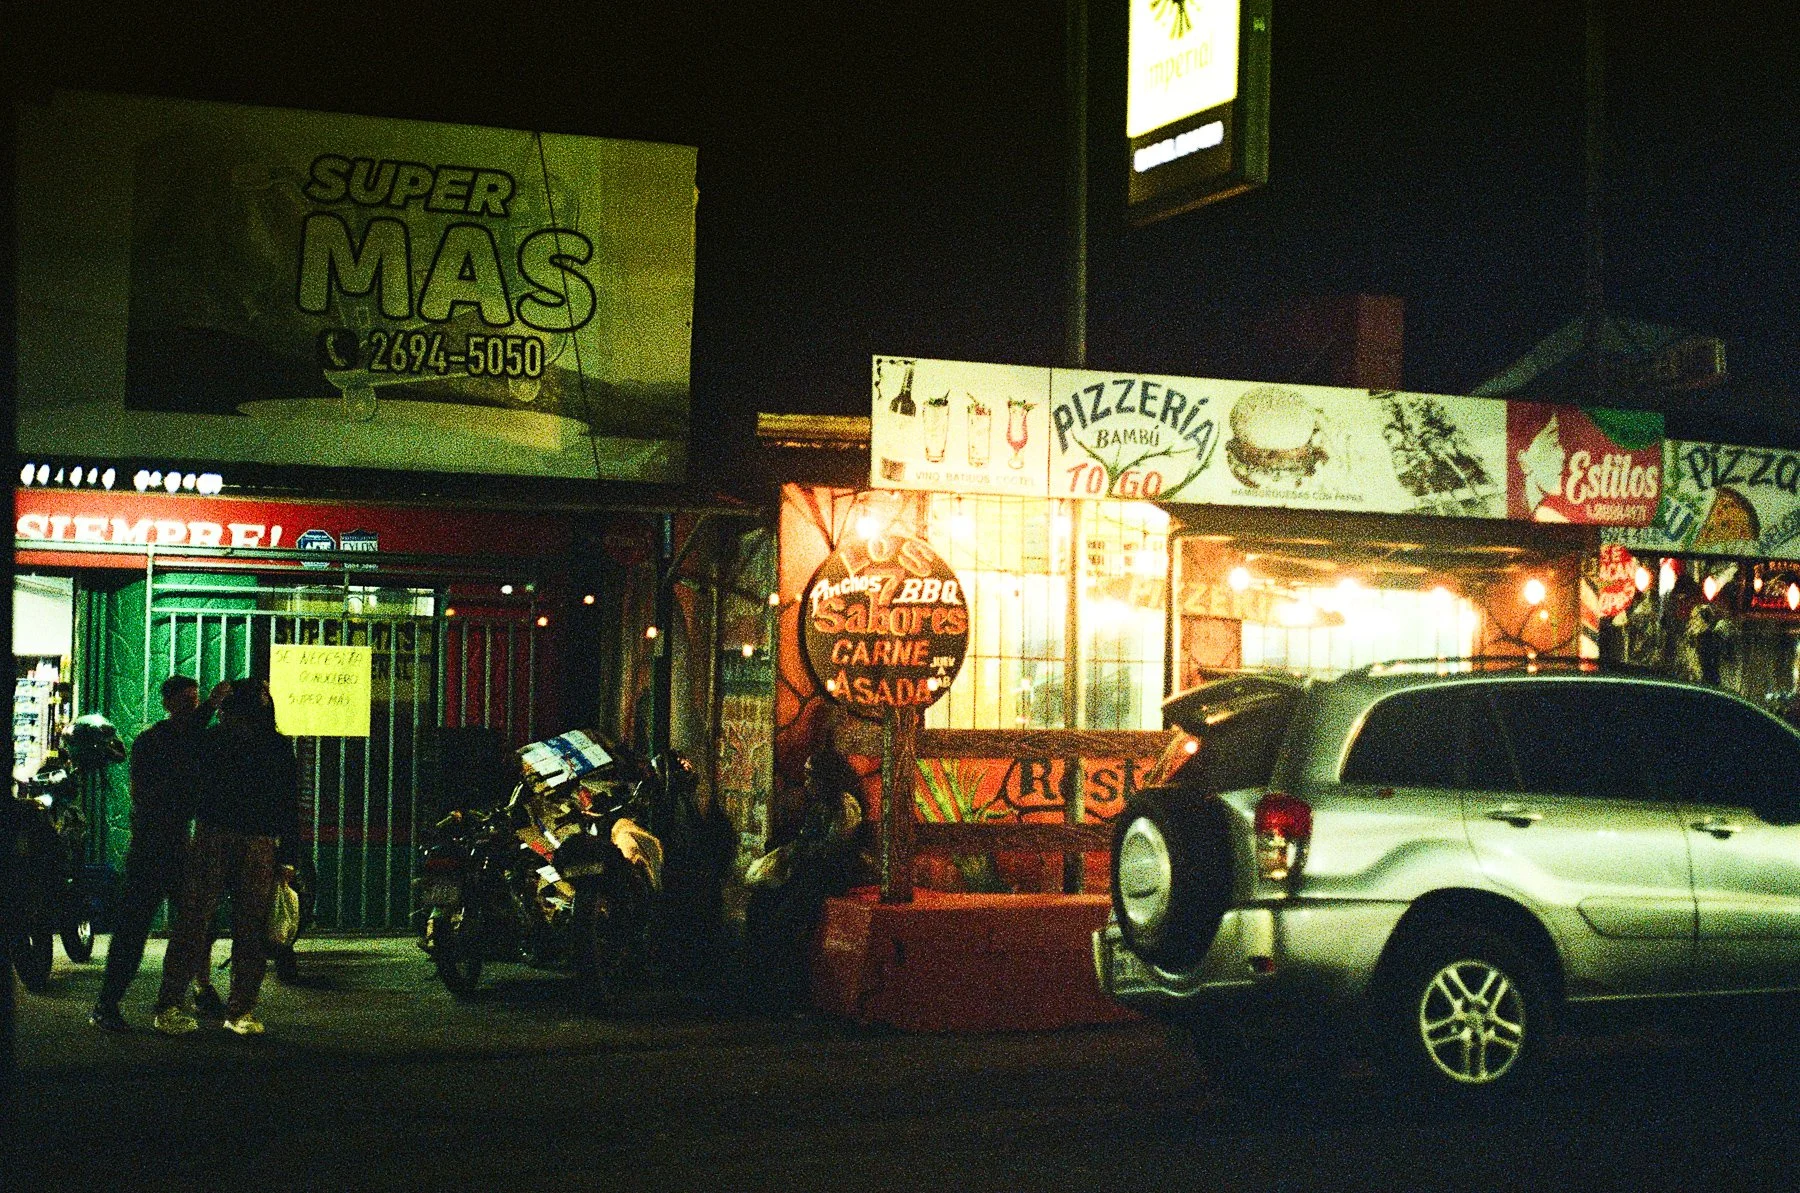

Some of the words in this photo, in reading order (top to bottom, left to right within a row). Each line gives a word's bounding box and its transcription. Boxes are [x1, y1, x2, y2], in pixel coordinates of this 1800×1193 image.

[303, 153, 516, 218] SUPER
[299, 211, 597, 333] MAS
[368, 331, 546, 378] 2694-5050
[1052, 378, 1215, 461] PIZZERÍA
[1096, 425, 1161, 449] BAMBÚ
[1066, 462, 1104, 495] TO
[1119, 470, 1164, 498] GO
[1566, 450, 1658, 504] Estilos
[839, 536, 934, 578] LOS
[892, 578, 962, 606] BBQ
[814, 596, 968, 637] Sabores
[831, 639, 931, 666] CARNE
[833, 669, 933, 706] ASADA
